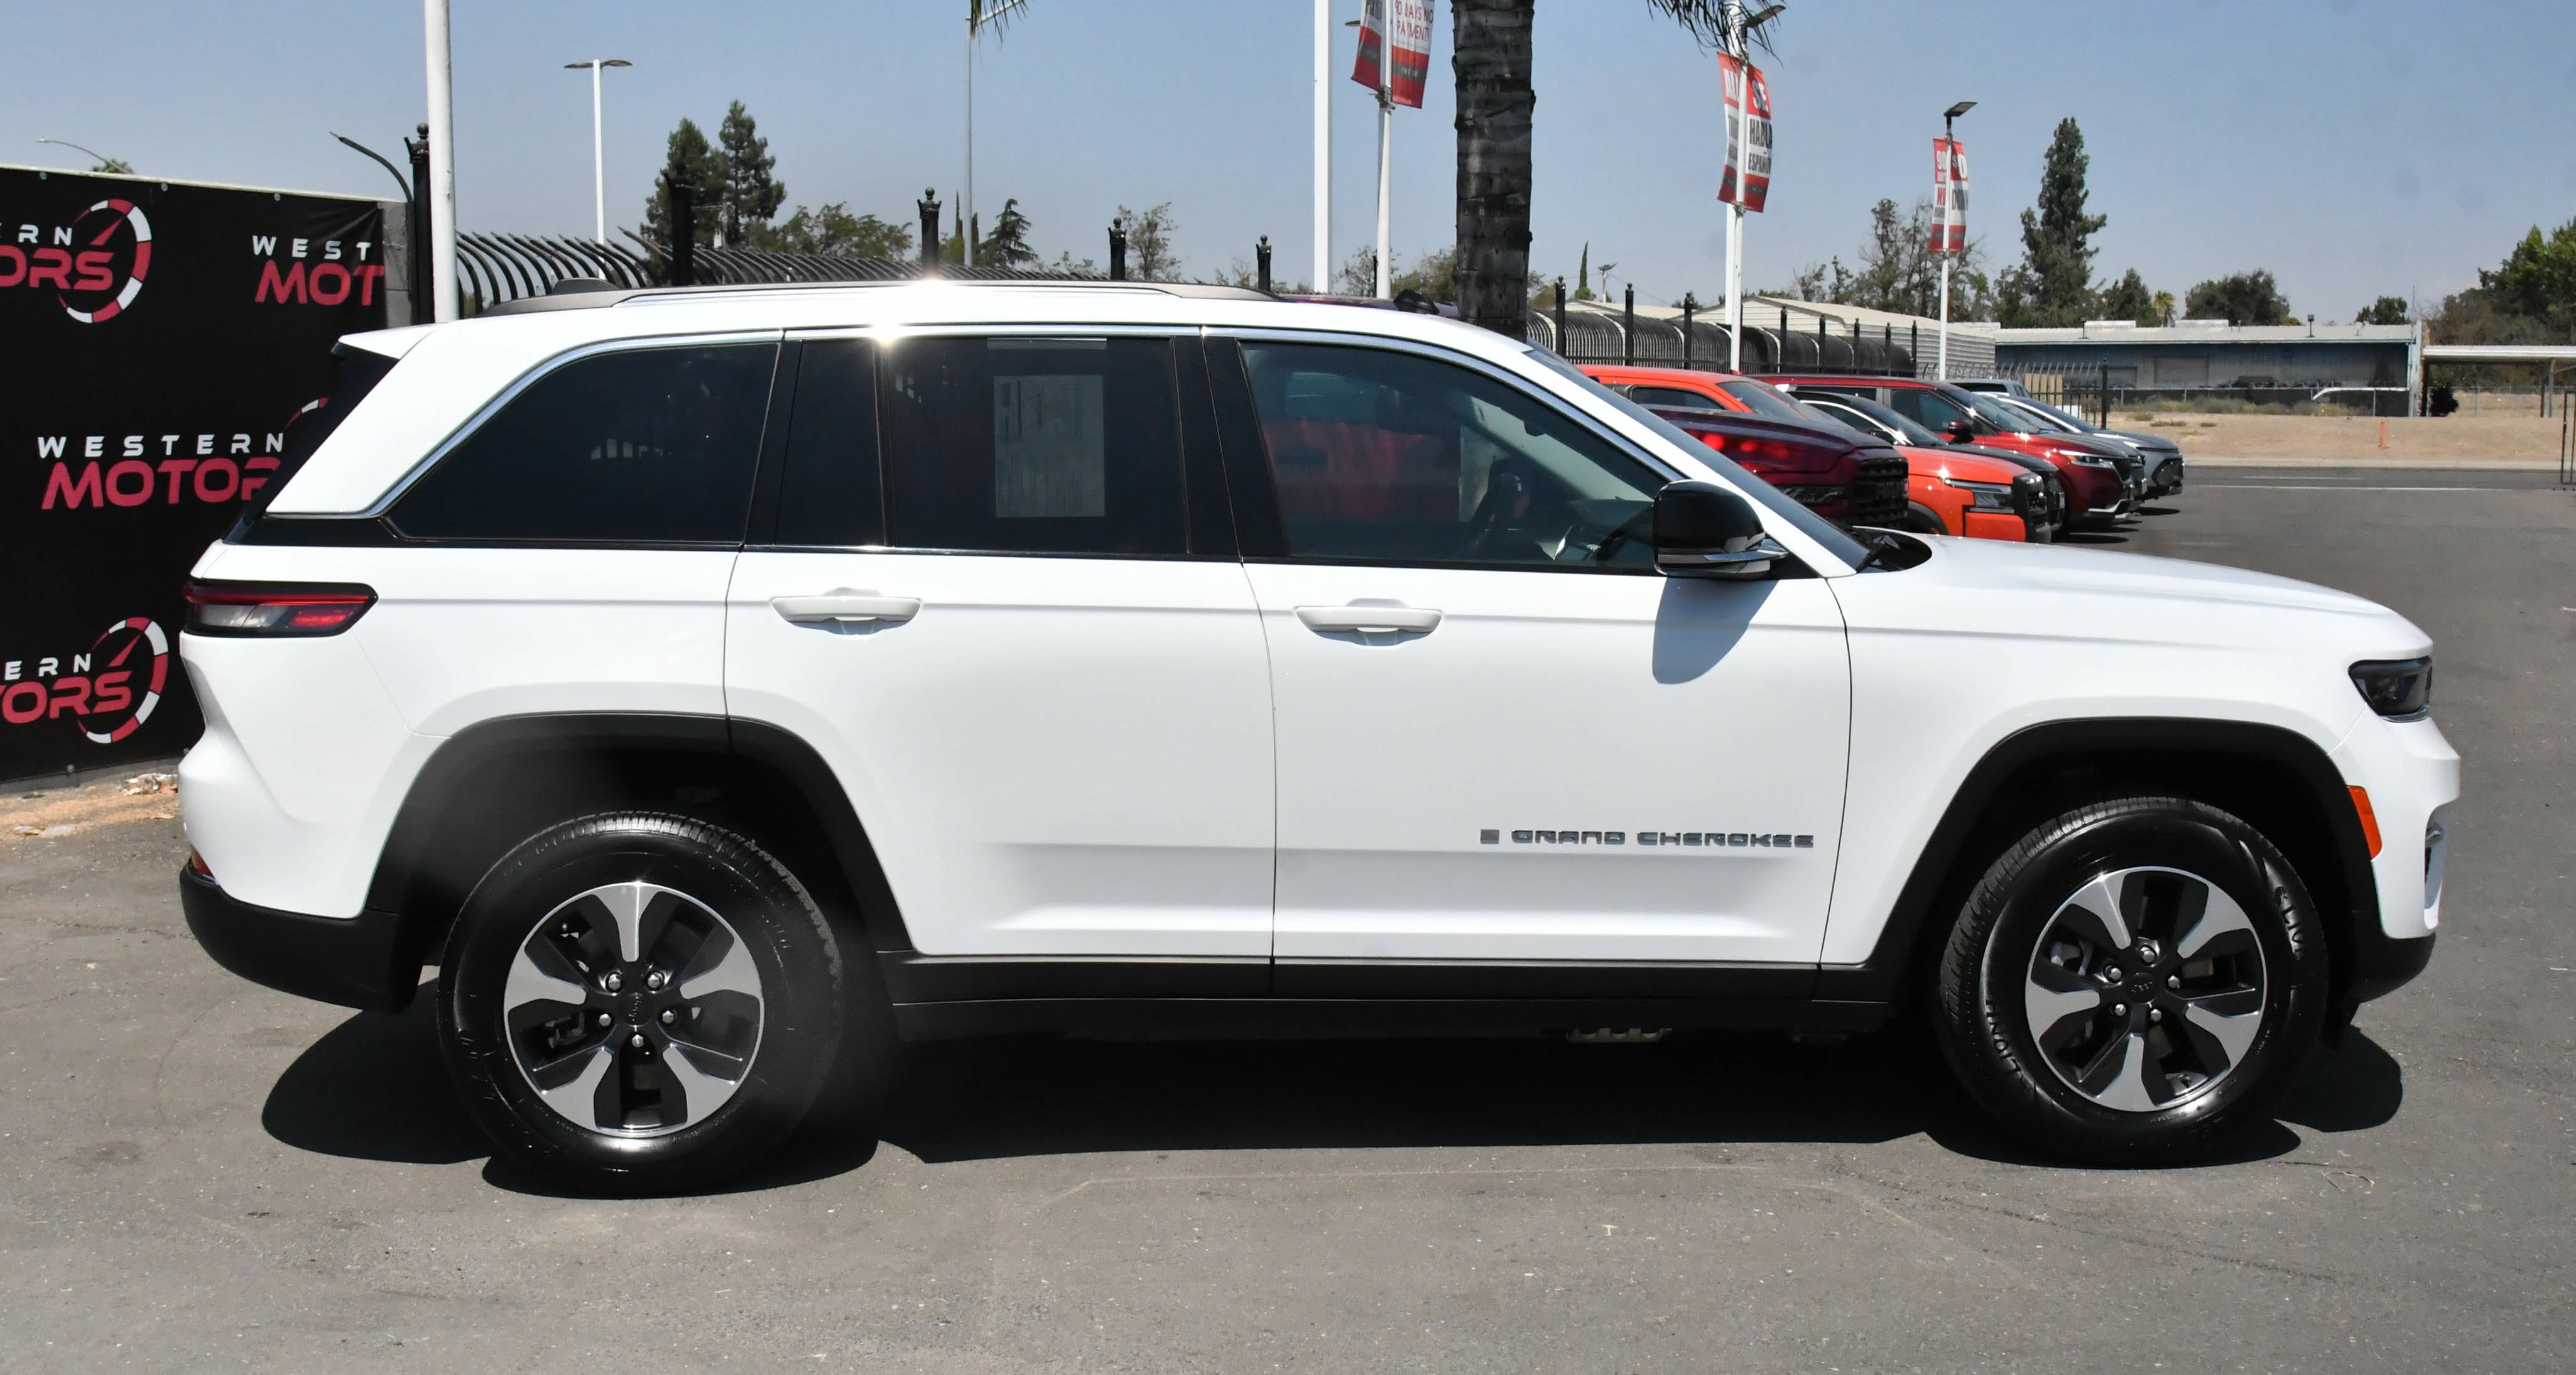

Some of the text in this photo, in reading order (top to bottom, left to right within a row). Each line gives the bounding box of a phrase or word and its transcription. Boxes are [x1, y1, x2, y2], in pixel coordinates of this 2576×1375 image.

[1424, 7, 1434, 24] NO
[252, 235, 372, 261] WEST
[254, 259, 384, 306] MOT
[38, 432, 284, 459] WESTERN
[1511, 829, 1814, 848] GRAND CHEROKEE
